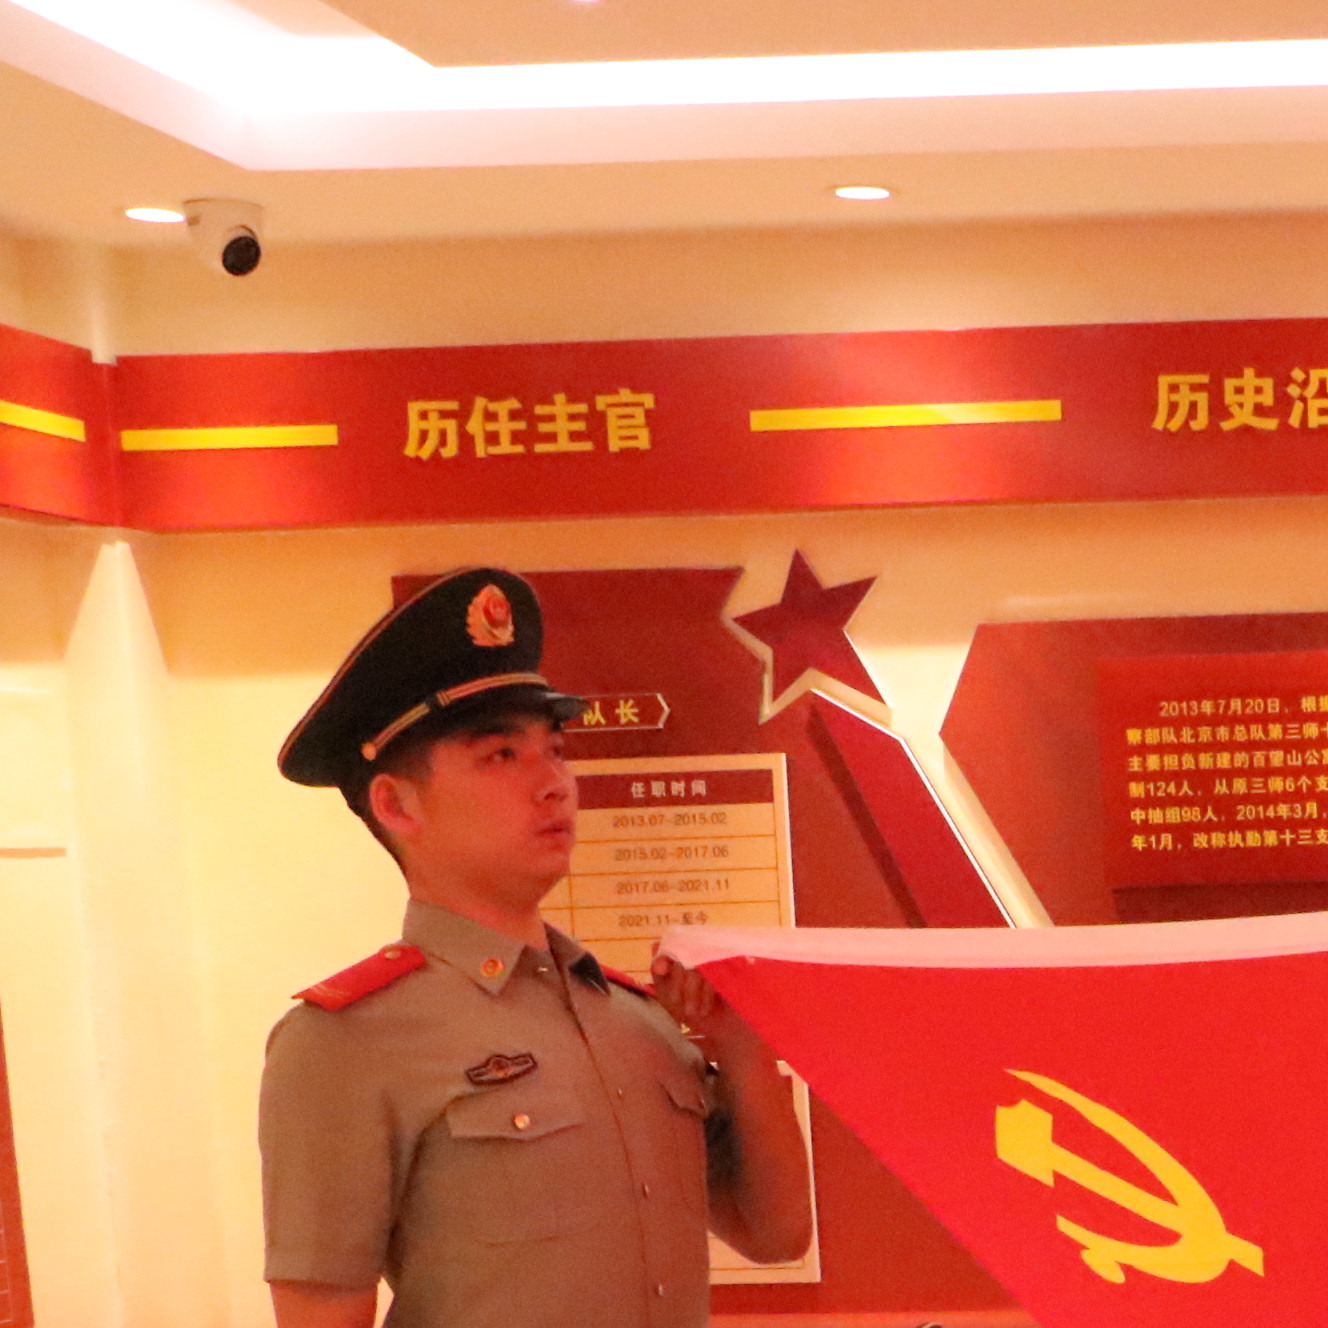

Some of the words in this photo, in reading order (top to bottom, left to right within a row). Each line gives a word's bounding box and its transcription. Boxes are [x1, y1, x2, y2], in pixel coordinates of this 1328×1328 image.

[404, 387, 656, 462] 历任主官
[631, 780, 707, 798] 任职时间
